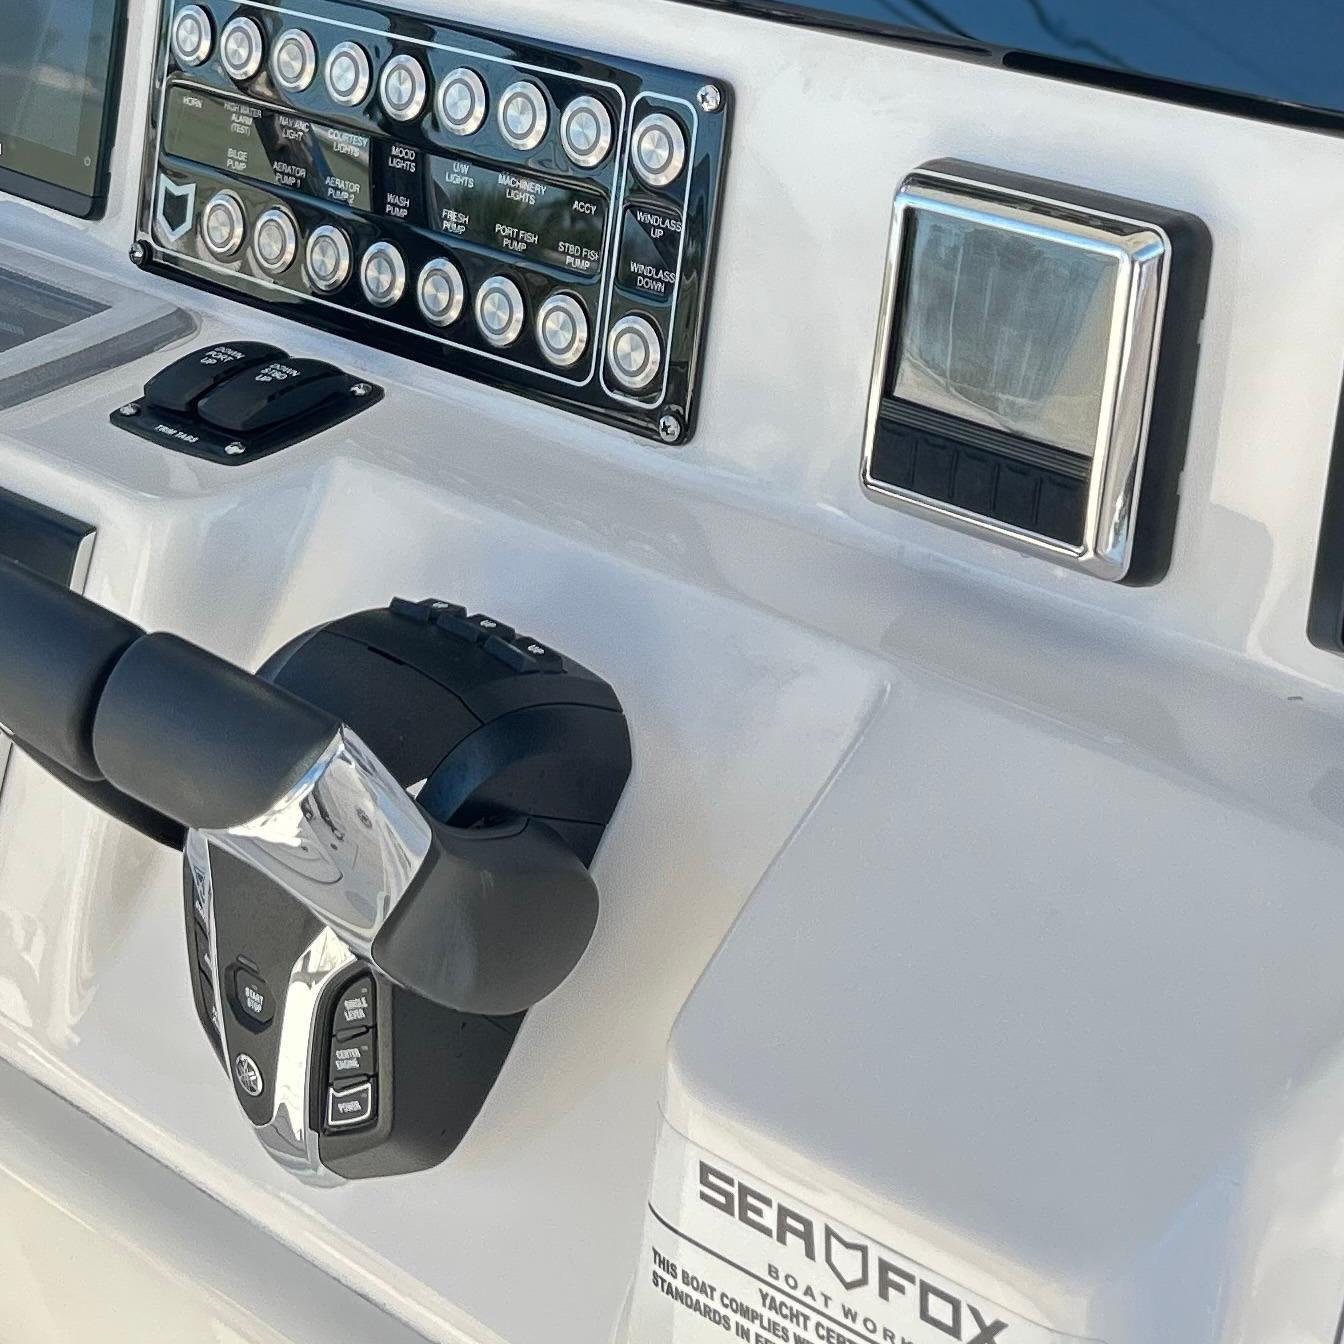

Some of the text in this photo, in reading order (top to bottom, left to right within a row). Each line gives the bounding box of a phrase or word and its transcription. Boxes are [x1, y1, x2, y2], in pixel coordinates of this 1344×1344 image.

[182, 96, 203, 109] HORN
[282, 129, 304, 141] LIGHT
[327, 129, 370, 147] COURTESY
[227, 148, 248, 161] BILGE
[333, 141, 360, 157] LIGHTS
[391, 145, 416, 160] MOOD
[226, 159, 246, 171] PUMP
[273, 161, 306, 177] AERATOR
[388, 158, 416, 173] LIGHTS
[275, 173, 296, 187] PUMP
[325, 176, 360, 193] AERATOR
[445, 172, 474, 189] LIGHTS
[498, 173, 547, 196] MACHINERY
[327, 188, 348, 203] PUMP
[386, 193, 410, 208] WASH
[505, 188, 536, 206] LIGHTS
[385, 204, 408, 218] PUMP
[572, 200, 597, 215] ACCY
[442, 209, 469, 225] FRESH
[637, 210, 683, 232] WINDLASS
[442, 221, 466, 235] PUMP
[495, 223, 539, 245] PORT FISH
[650, 227, 664, 239] UP
[503, 238, 527, 252] PUMP
[558, 241, 581, 257] STBD
[565, 256, 590, 271] PUMP
[630, 260, 677, 284] WINDLASS
[637, 277, 665, 293] DOWN
[698, 1159, 1010, 1344] SEA FOX
[768, 1263, 832, 1307] BOAT
[652, 1246, 790, 1343] THIS BOAT COMPLIES
[652, 1270, 751, 1344] STANDARDS IN
[759, 1287, 811, 1332] YACHT
